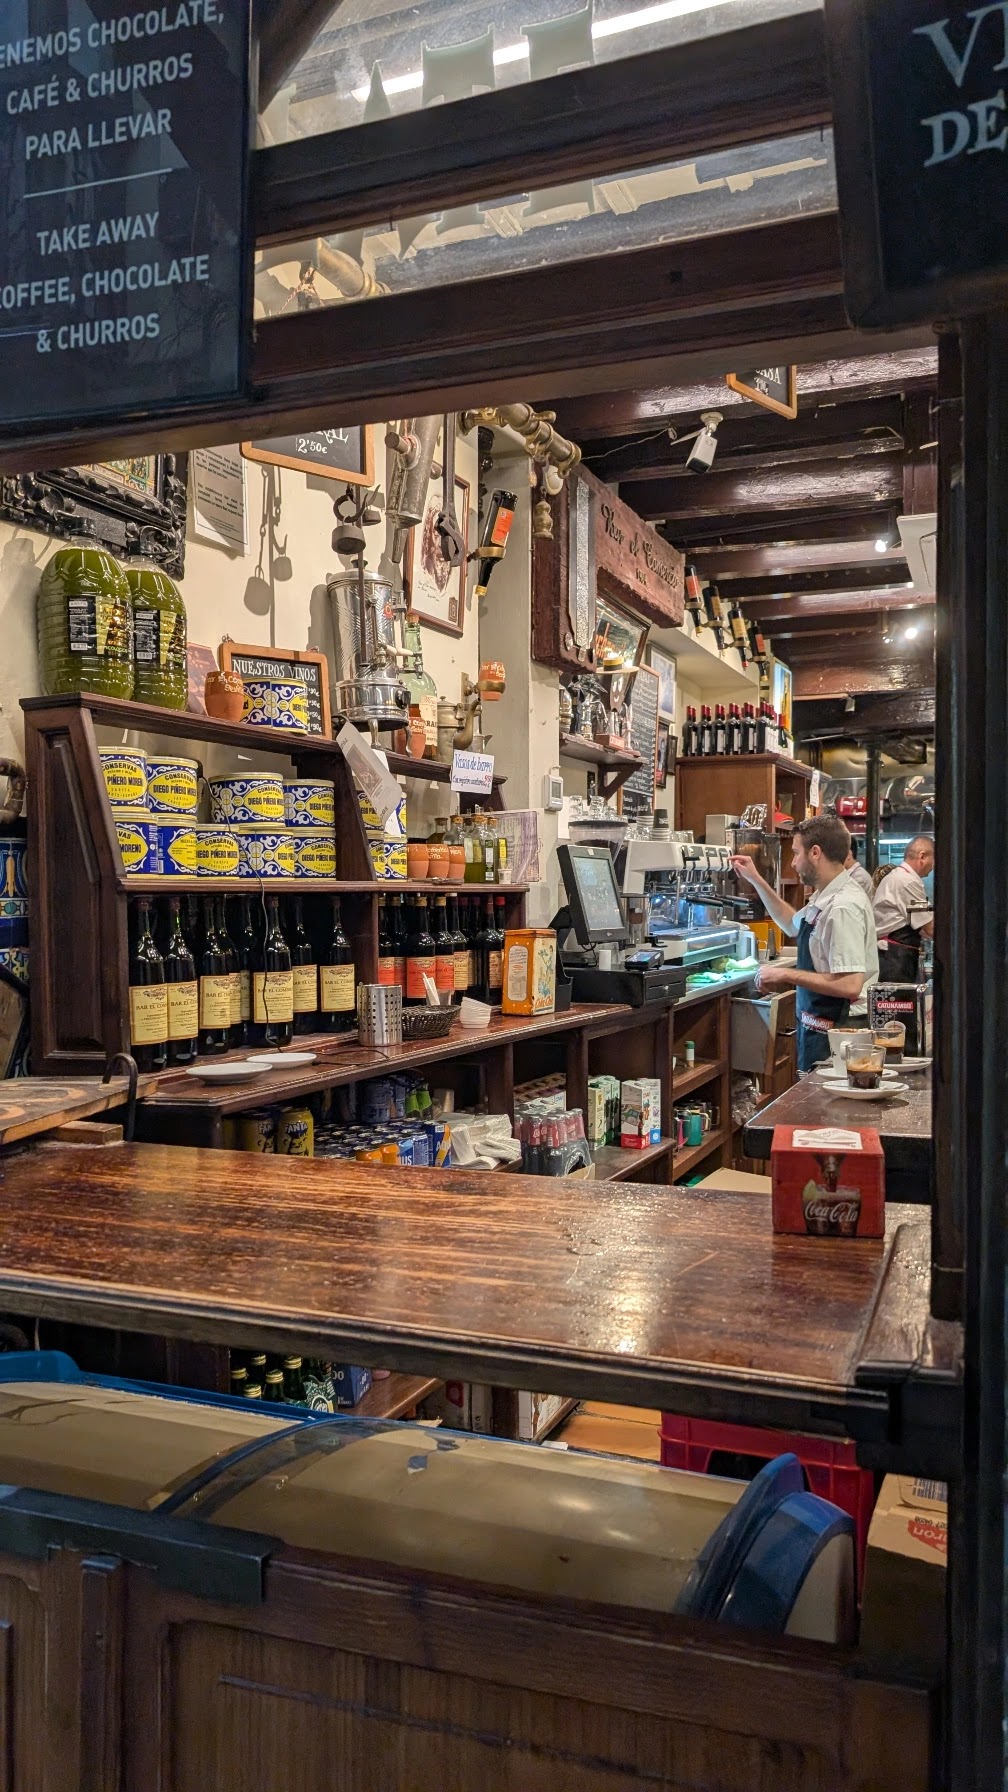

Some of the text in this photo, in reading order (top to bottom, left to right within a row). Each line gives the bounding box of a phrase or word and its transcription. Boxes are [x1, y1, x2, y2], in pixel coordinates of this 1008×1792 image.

[87, 0, 224, 48] CHOCOLATE,
[912, 1, 1008, 88] V
[6, 53, 193, 116] CAFÉ & CHURROS
[25, 109, 171, 160] PARA LLEVAR
[36, 212, 159, 256] TAKE AWAY
[81, 255, 210, 298] CHOCOLATE
[36, 313, 160, 353] & CHURROS
[233, 658, 317, 682] NUESTROS VINOS
[153, 785, 169, 793] DIEGO
[284, 1123, 308, 1133] FANTA
